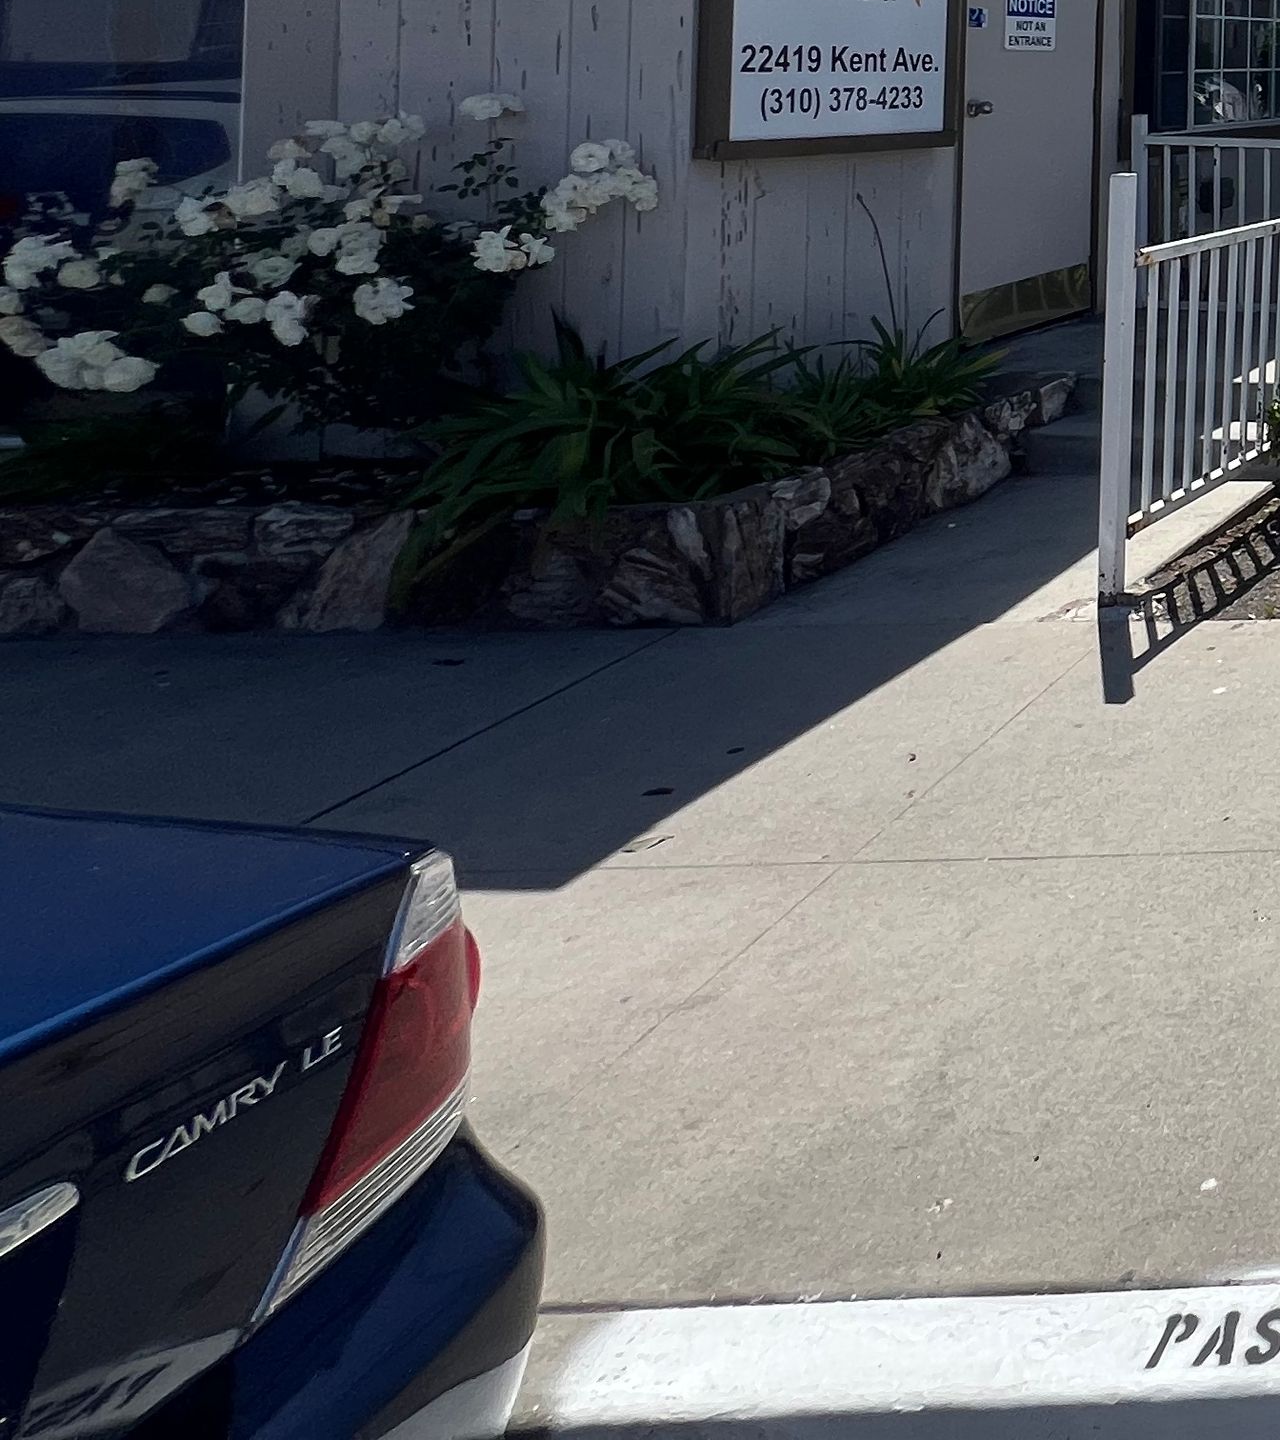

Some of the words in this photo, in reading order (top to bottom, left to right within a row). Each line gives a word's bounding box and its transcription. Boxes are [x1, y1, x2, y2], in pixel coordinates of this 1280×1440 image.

[1016, 20, 1034, 32] NOT
[1034, 21, 1046, 32] AN
[1008, 35, 1052, 47] ENTRANCE
[740, 44, 822, 73] 22419
[830, 45, 887, 73] Kent
[892, 47, 939, 73] Ave.
[761, 87, 820, 122] (310)
[829, 86, 923, 112] 378-4233
[126, 1061, 286, 1182] CAMRY
[303, 1026, 342, 1072] LE
